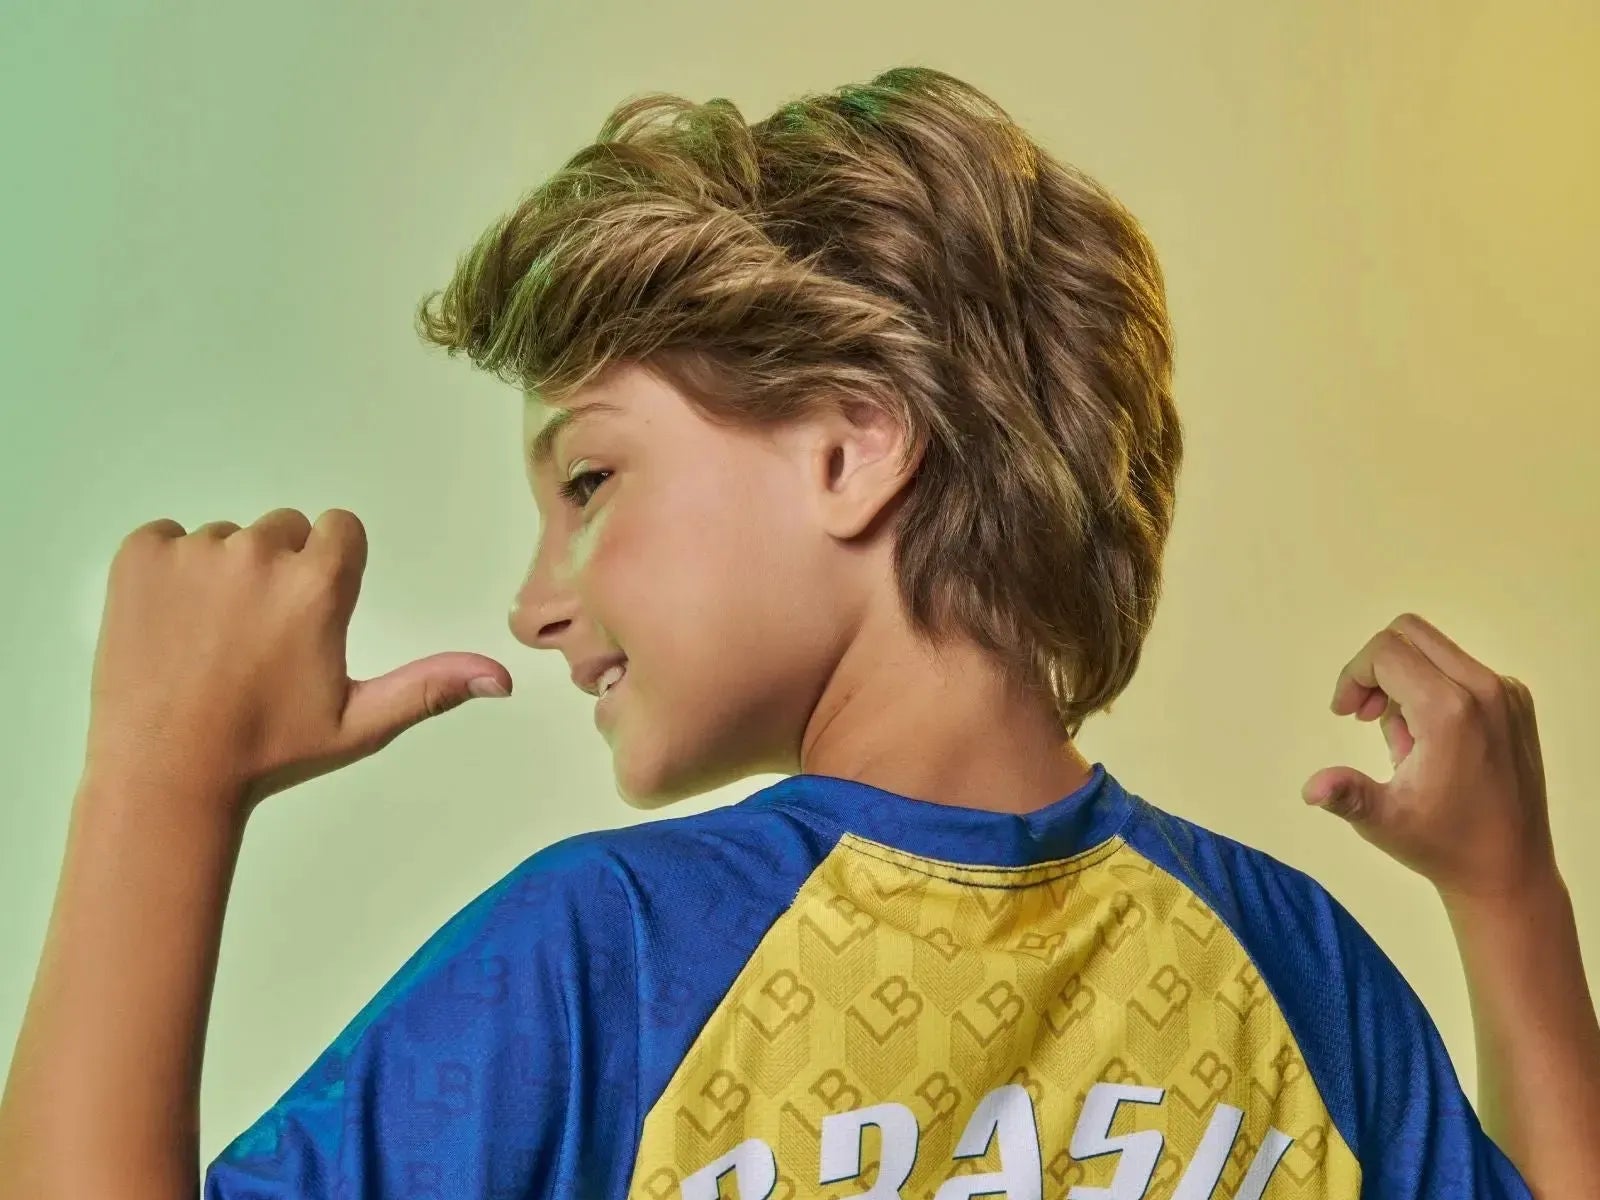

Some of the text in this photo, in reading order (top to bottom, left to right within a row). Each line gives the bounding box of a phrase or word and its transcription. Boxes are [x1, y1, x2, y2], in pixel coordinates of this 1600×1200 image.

[799, 894, 878, 955] LB
[738, 968, 816, 1042] LB
[846, 975, 924, 1046] LB
[951, 980, 1025, 1049] LB
[1040, 972, 1097, 1038] LB
[1127, 964, 1193, 1032] LB
[675, 1069, 751, 1142] LB
[1169, 1052, 1233, 1118] LB
[1277, 1124, 1328, 1187] LB
